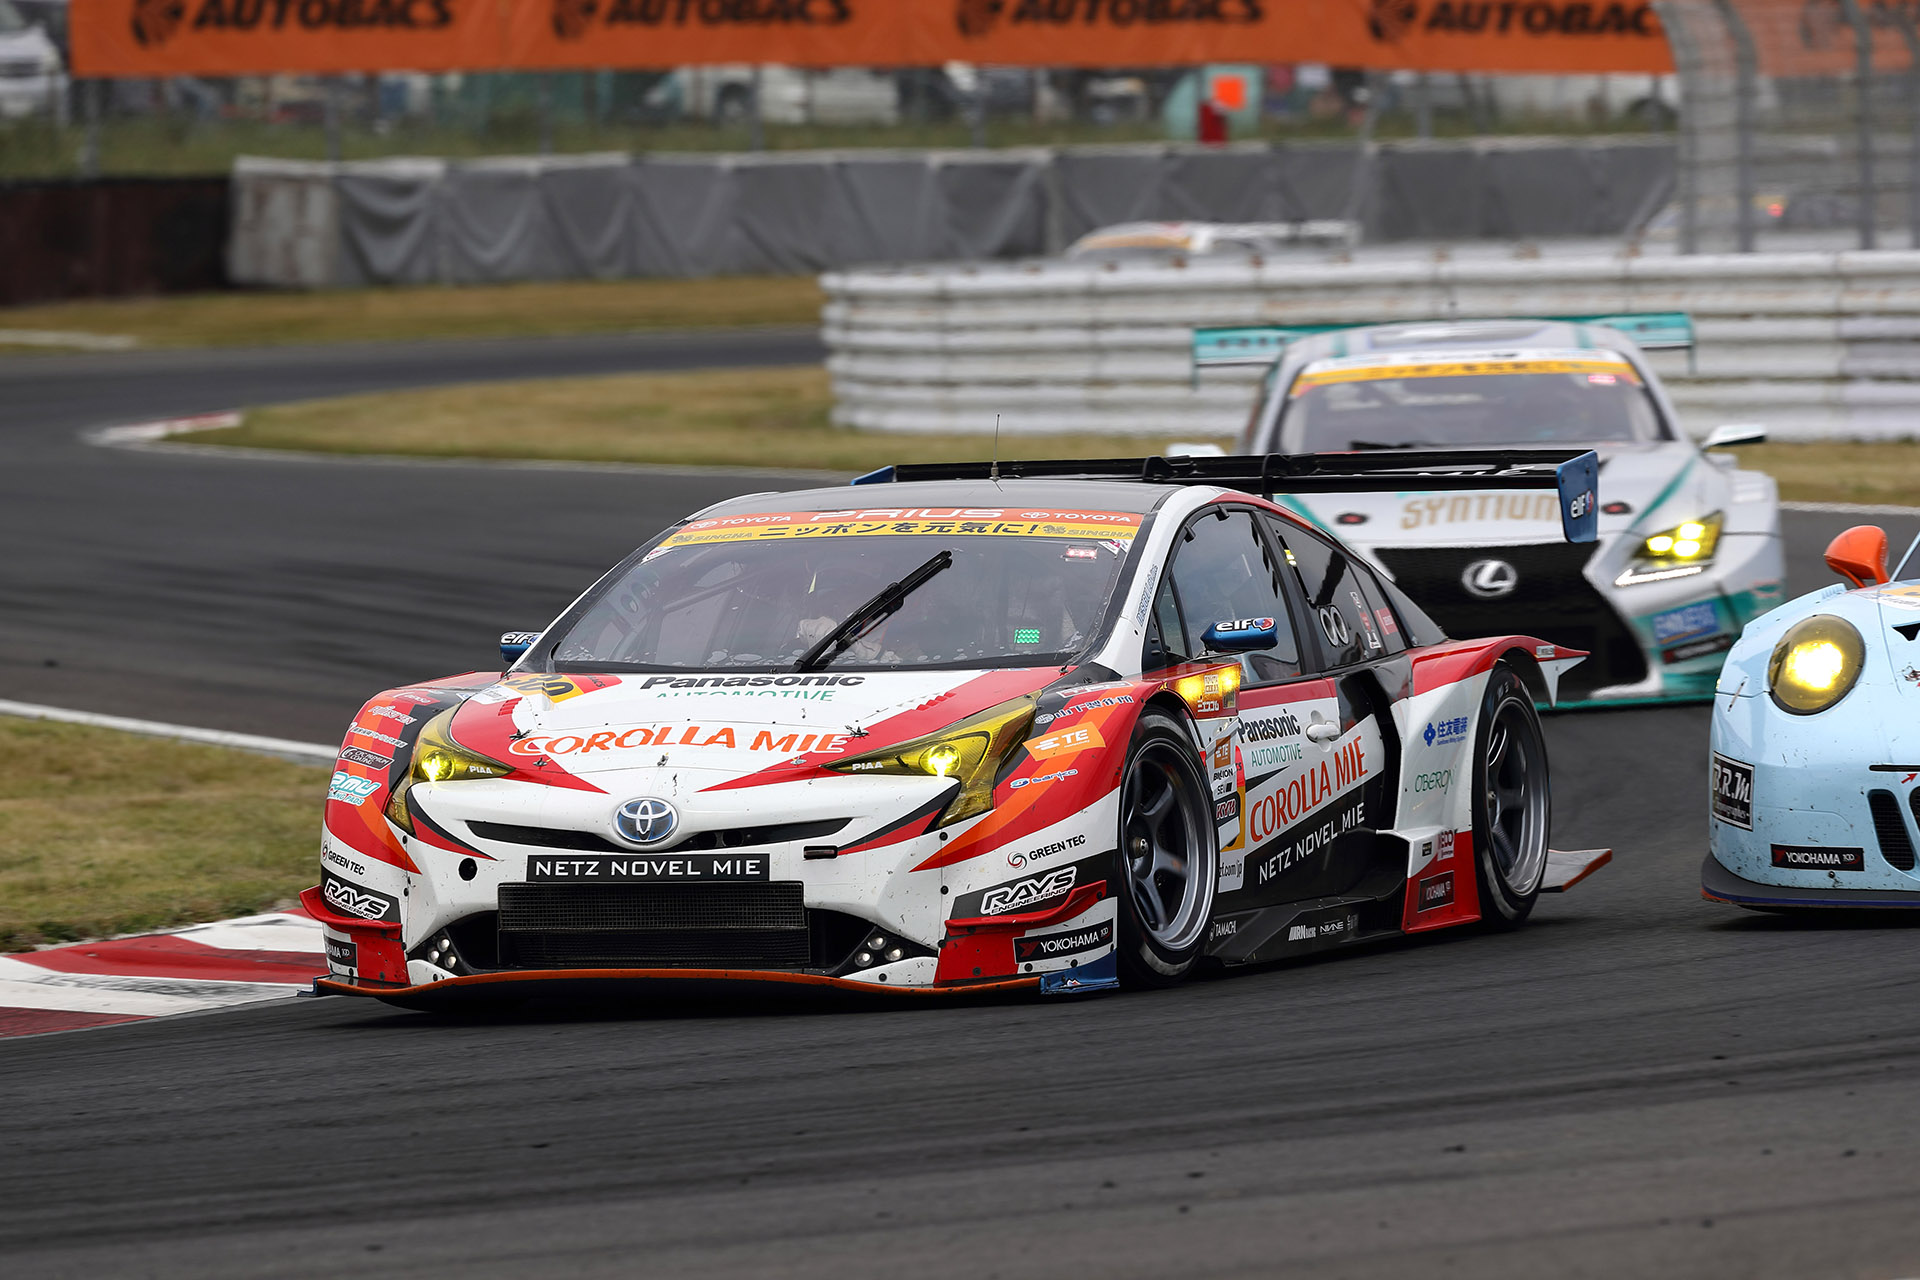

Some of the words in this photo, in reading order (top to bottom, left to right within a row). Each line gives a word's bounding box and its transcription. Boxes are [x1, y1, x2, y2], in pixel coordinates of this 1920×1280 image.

[193, 0, 452, 30] AUTOBACS
[1424, 0, 1655, 35] AUTOBAC
[810, 508, 1004, 521] PRIUS
[1054, 513, 1131, 523] TOYOTA
[1402, 495, 1562, 529] SYNTIUM
[1571, 493, 1586, 518] elf
[721, 516, 791, 525] TOYOTA
[1067, 528, 1135, 538] SINGHA
[1215, 619, 1253, 632] elf
[501, 632, 532, 645] elf
[640, 674, 865, 690] Panasonic
[1062, 729, 1089, 744] TE
[1237, 709, 1300, 744] Panasonic
[511, 725, 736, 754] COROLLA
[750, 730, 852, 752] MIE
[852, 760, 884, 772] PIAA
[1251, 743, 1302, 768] AUTOMOTIVE
[469, 765, 493, 775] PIAA
[1251, 760, 1332, 842] COROLLA
[1334, 736, 1368, 791] MIE
[1029, 841, 1066, 861] GREEN
[1066, 834, 1086, 849] TEC
[1259, 847, 1291, 885] NETZ
[1296, 820, 1338, 862] NOVEL
[1342, 802, 1365, 832] MIE
[328, 850, 349, 869] GREEN
[350, 861, 365, 876] TEC
[535, 861, 599, 876] NETZ
[611, 860, 701, 876] NOVEL
[713, 859, 760, 875] MIE
[1785, 852, 1841, 865] YOKOHAMA
[325, 881, 388, 916] RAYS
[984, 870, 1075, 911] RAYS
[991, 887, 1067, 914] ENGINEERING
[1040, 932, 1099, 953] YOKOHAMA
